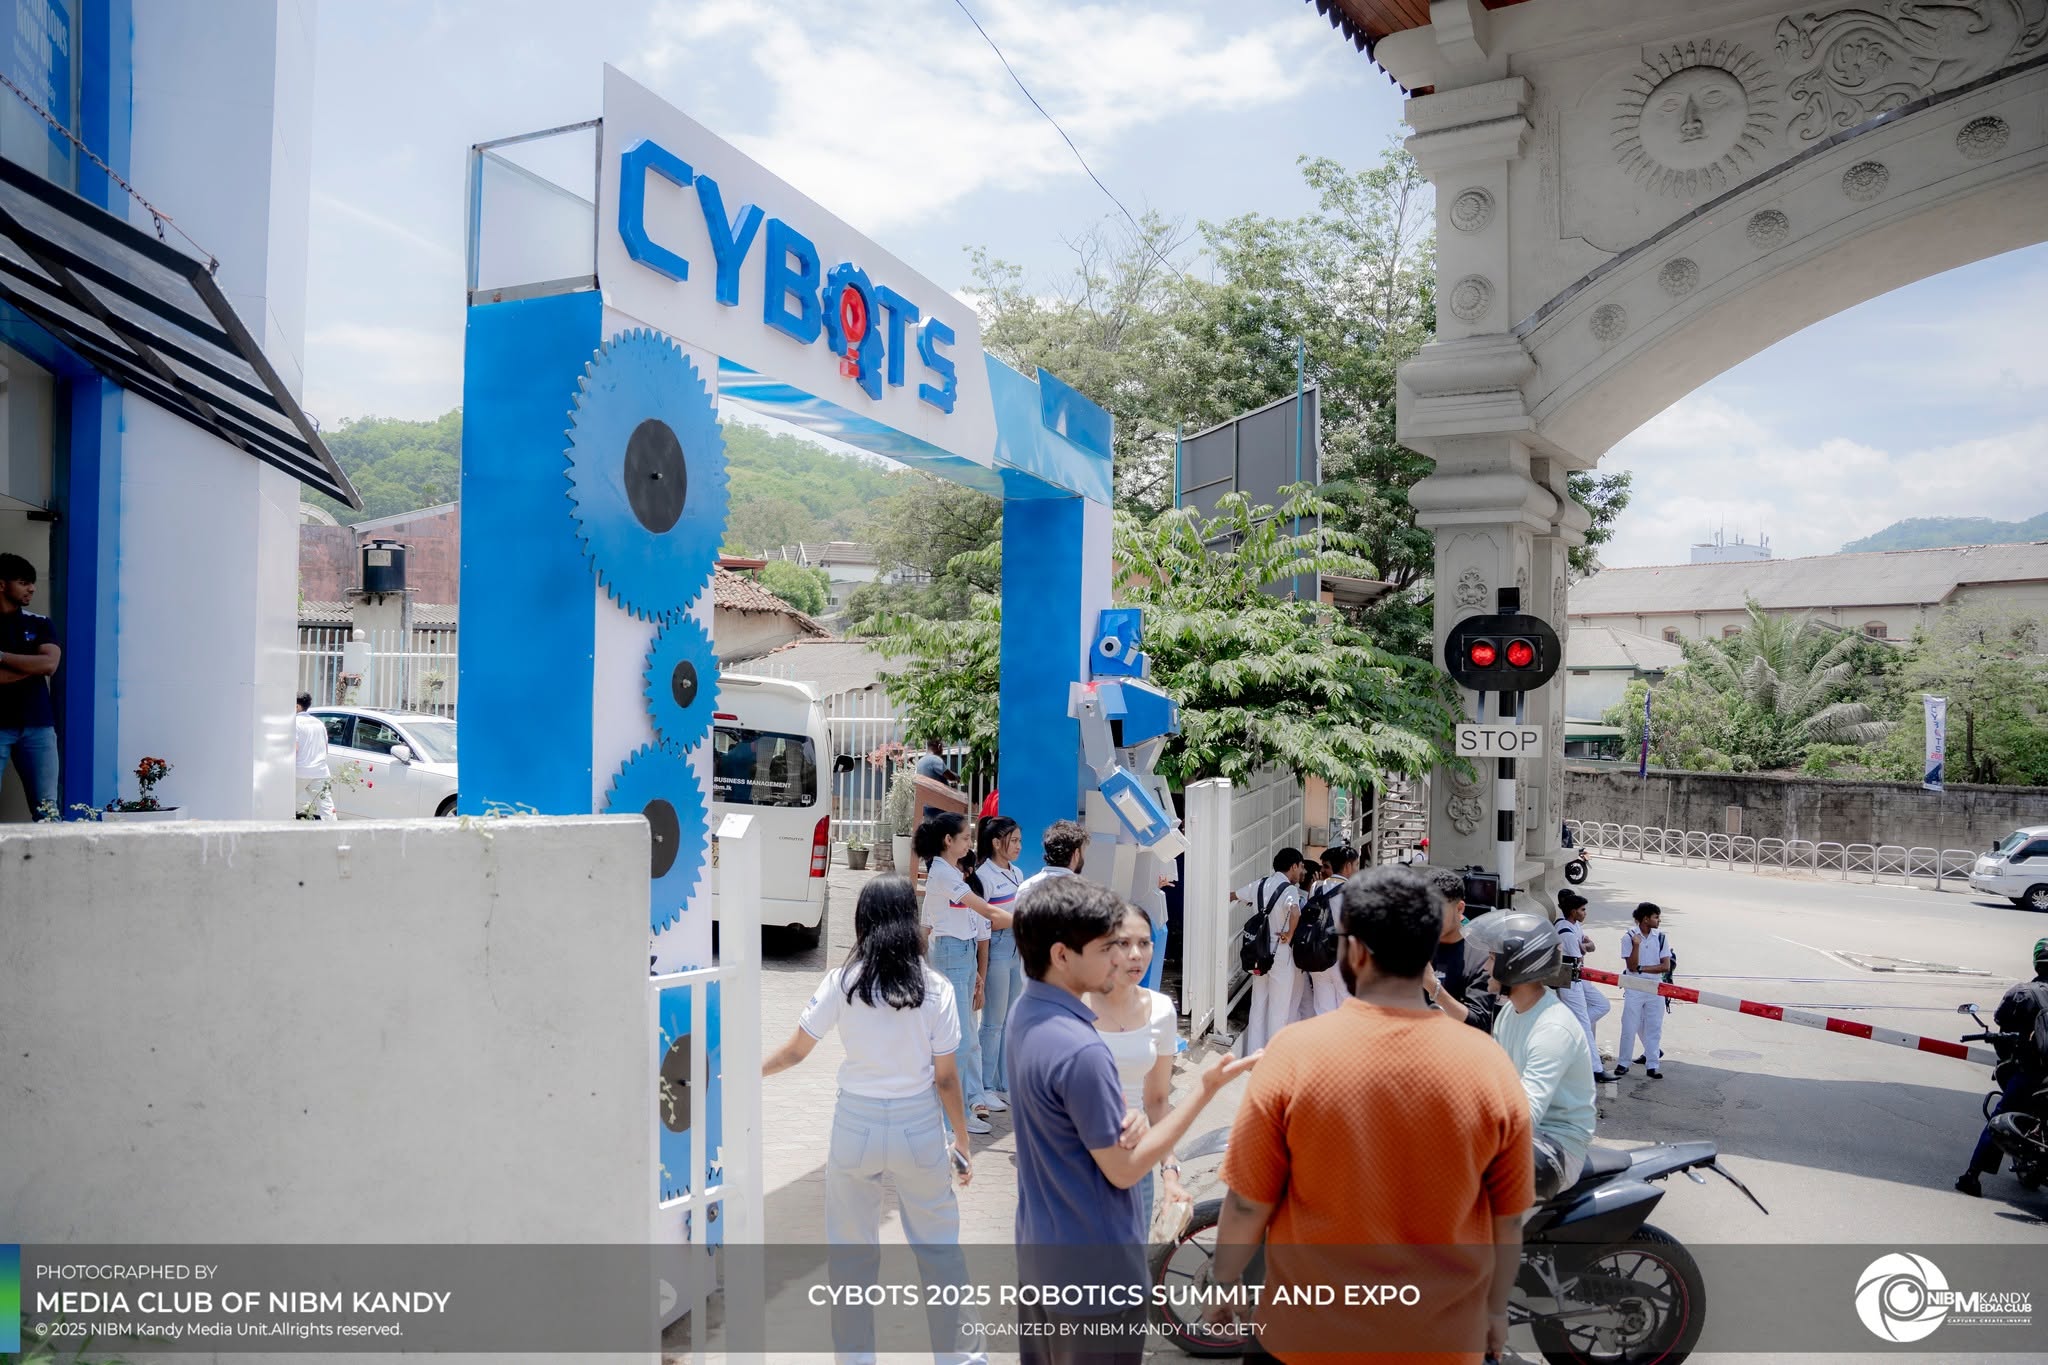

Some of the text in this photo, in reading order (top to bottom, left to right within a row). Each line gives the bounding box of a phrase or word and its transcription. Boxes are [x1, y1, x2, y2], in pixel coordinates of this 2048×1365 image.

[618, 139, 957, 414] CYBOTS
[1461, 730, 1538, 751] STOP
[713, 776, 792, 789] BUSINESS MANAGEMENT
